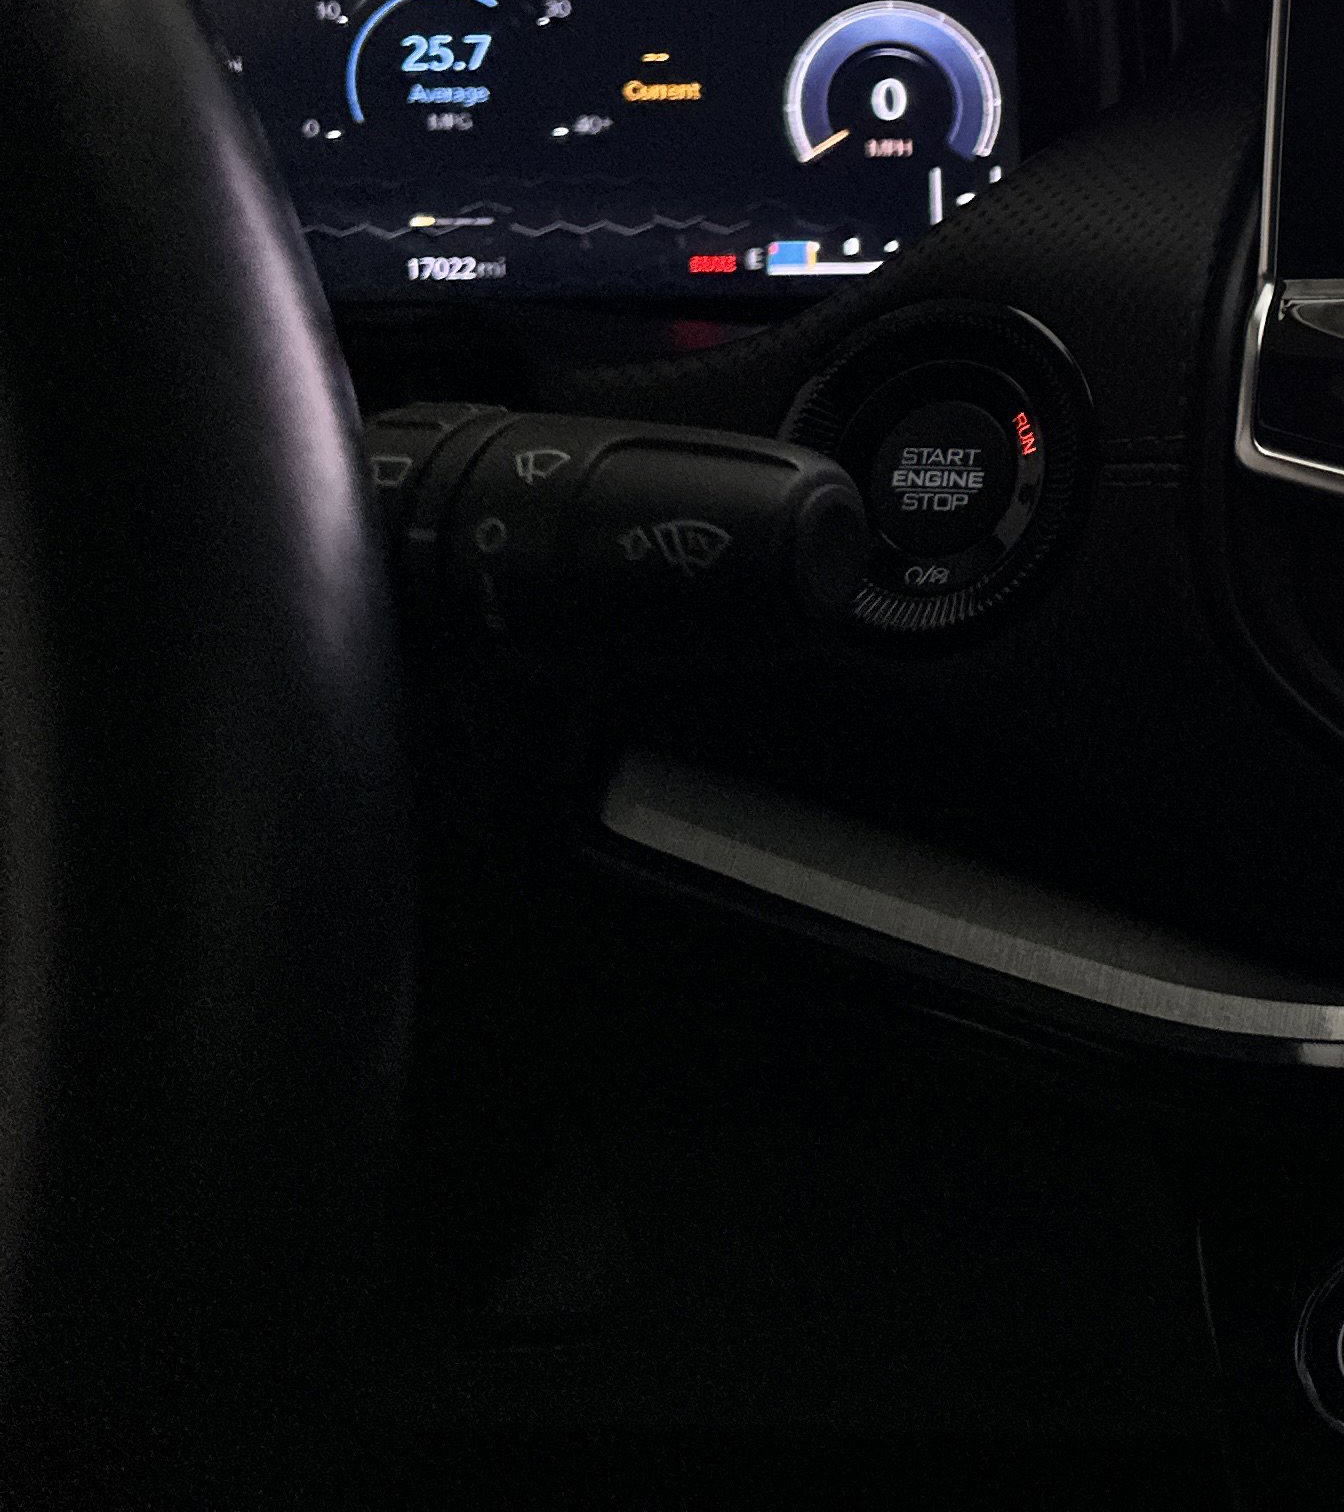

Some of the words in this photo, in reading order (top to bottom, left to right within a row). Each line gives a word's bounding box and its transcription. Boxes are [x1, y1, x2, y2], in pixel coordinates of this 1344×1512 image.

[401, 33, 492, 72] 25.7
[870, 77, 908, 121] 0
[407, 256, 478, 281] 17022
[1011, 411, 1038, 457] RUN
[899, 447, 981, 469] START
[889, 467, 988, 491] ENGINE
[901, 492, 969, 512] STOP
